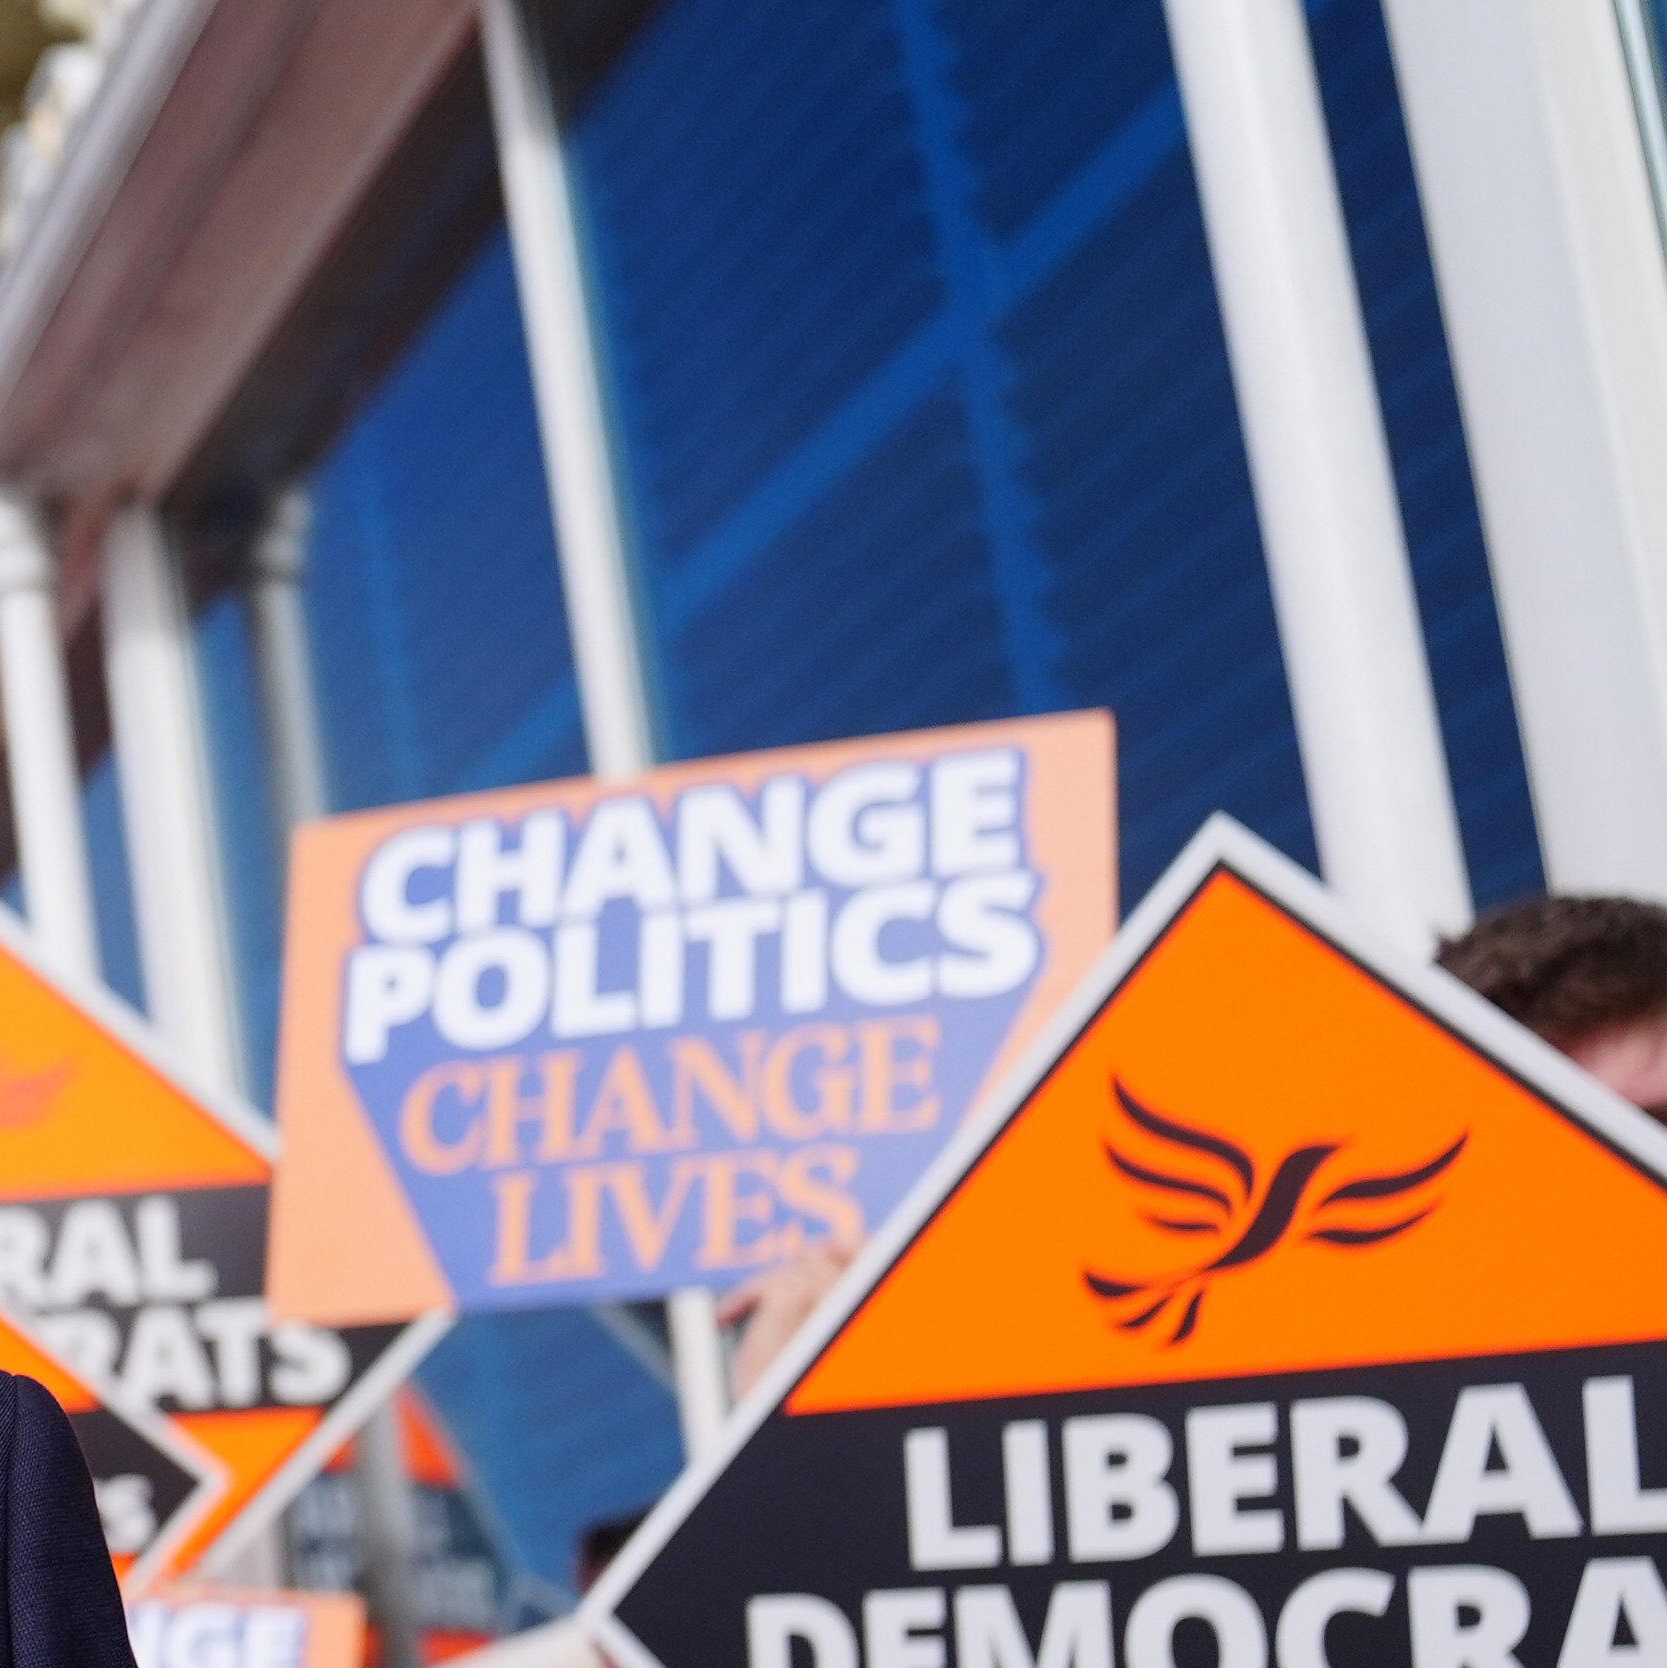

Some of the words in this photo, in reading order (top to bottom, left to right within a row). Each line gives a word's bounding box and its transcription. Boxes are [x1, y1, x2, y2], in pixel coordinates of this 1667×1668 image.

[362, 748, 1025, 945] CHANGE
[343, 873, 1041, 1064] POLITICS
[398, 1014, 943, 1175] CHANGE
[488, 1145, 867, 1286] LIVES
[904, 1375, 1667, 1571] LIBERAL
